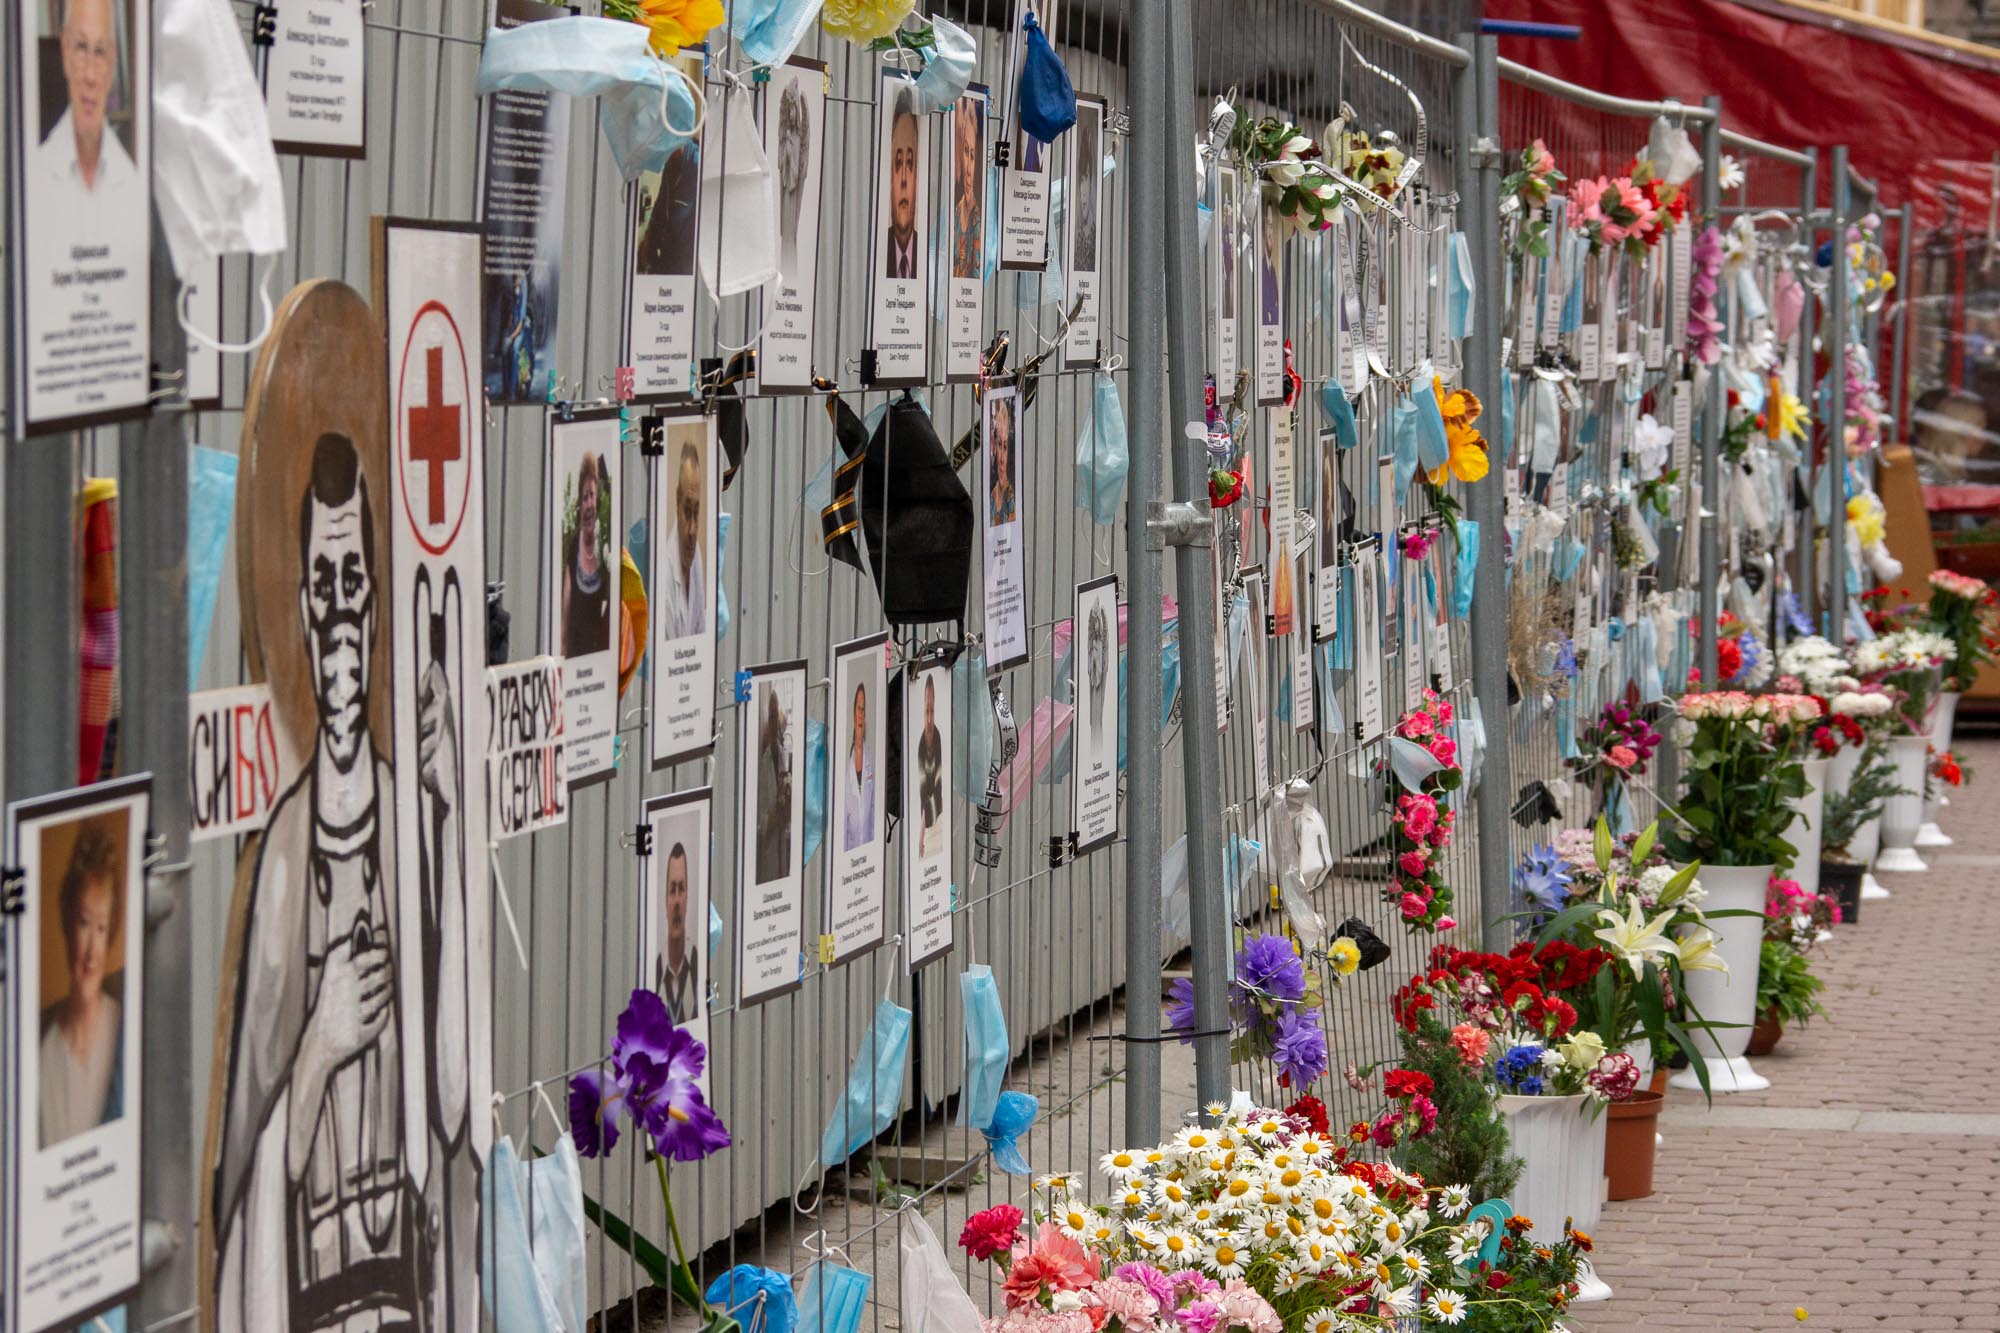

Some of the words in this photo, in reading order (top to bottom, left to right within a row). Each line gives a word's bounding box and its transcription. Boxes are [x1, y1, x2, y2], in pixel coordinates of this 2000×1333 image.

[498, 667, 564, 751] РАБРОЕ
[191, 701, 279, 829] СИБО
[500, 744, 565, 833] СЕРДЦЕ
